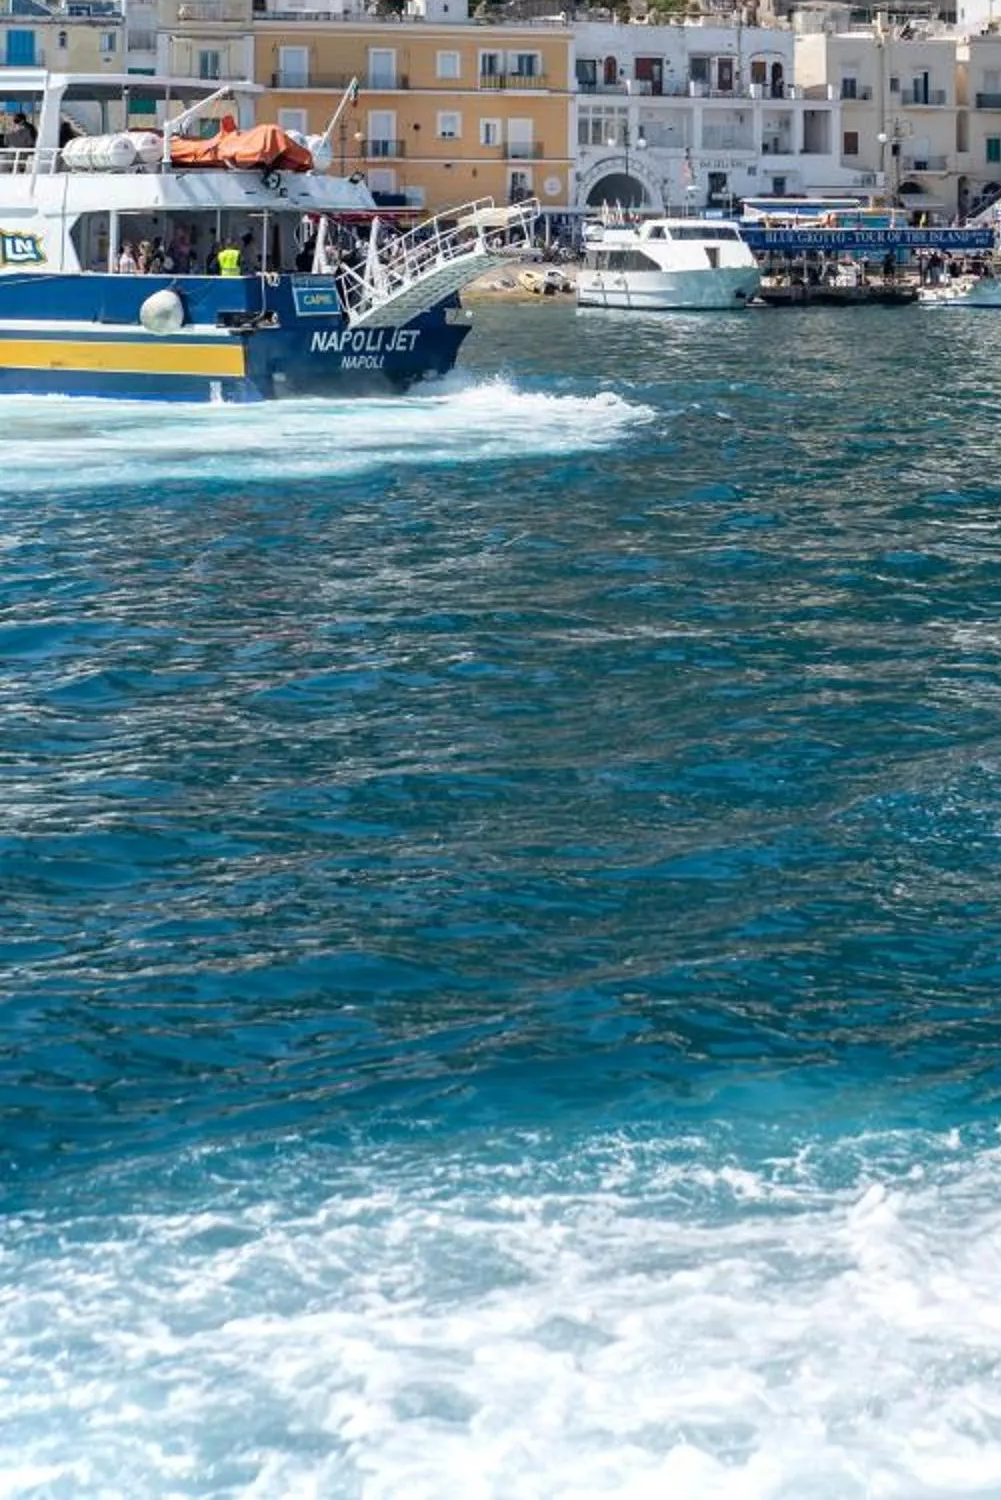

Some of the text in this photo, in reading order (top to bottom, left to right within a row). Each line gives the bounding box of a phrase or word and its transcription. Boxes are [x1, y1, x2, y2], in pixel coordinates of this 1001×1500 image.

[797, 231, 845, 243] GROTTO
[855, 231, 885, 243] TOUR
[886, 231, 902, 243] OF
[930, 231, 969, 243] ISLAND
[310, 329, 420, 352] NAPOLI JET
[341, 355, 384, 369] NAPOLI
